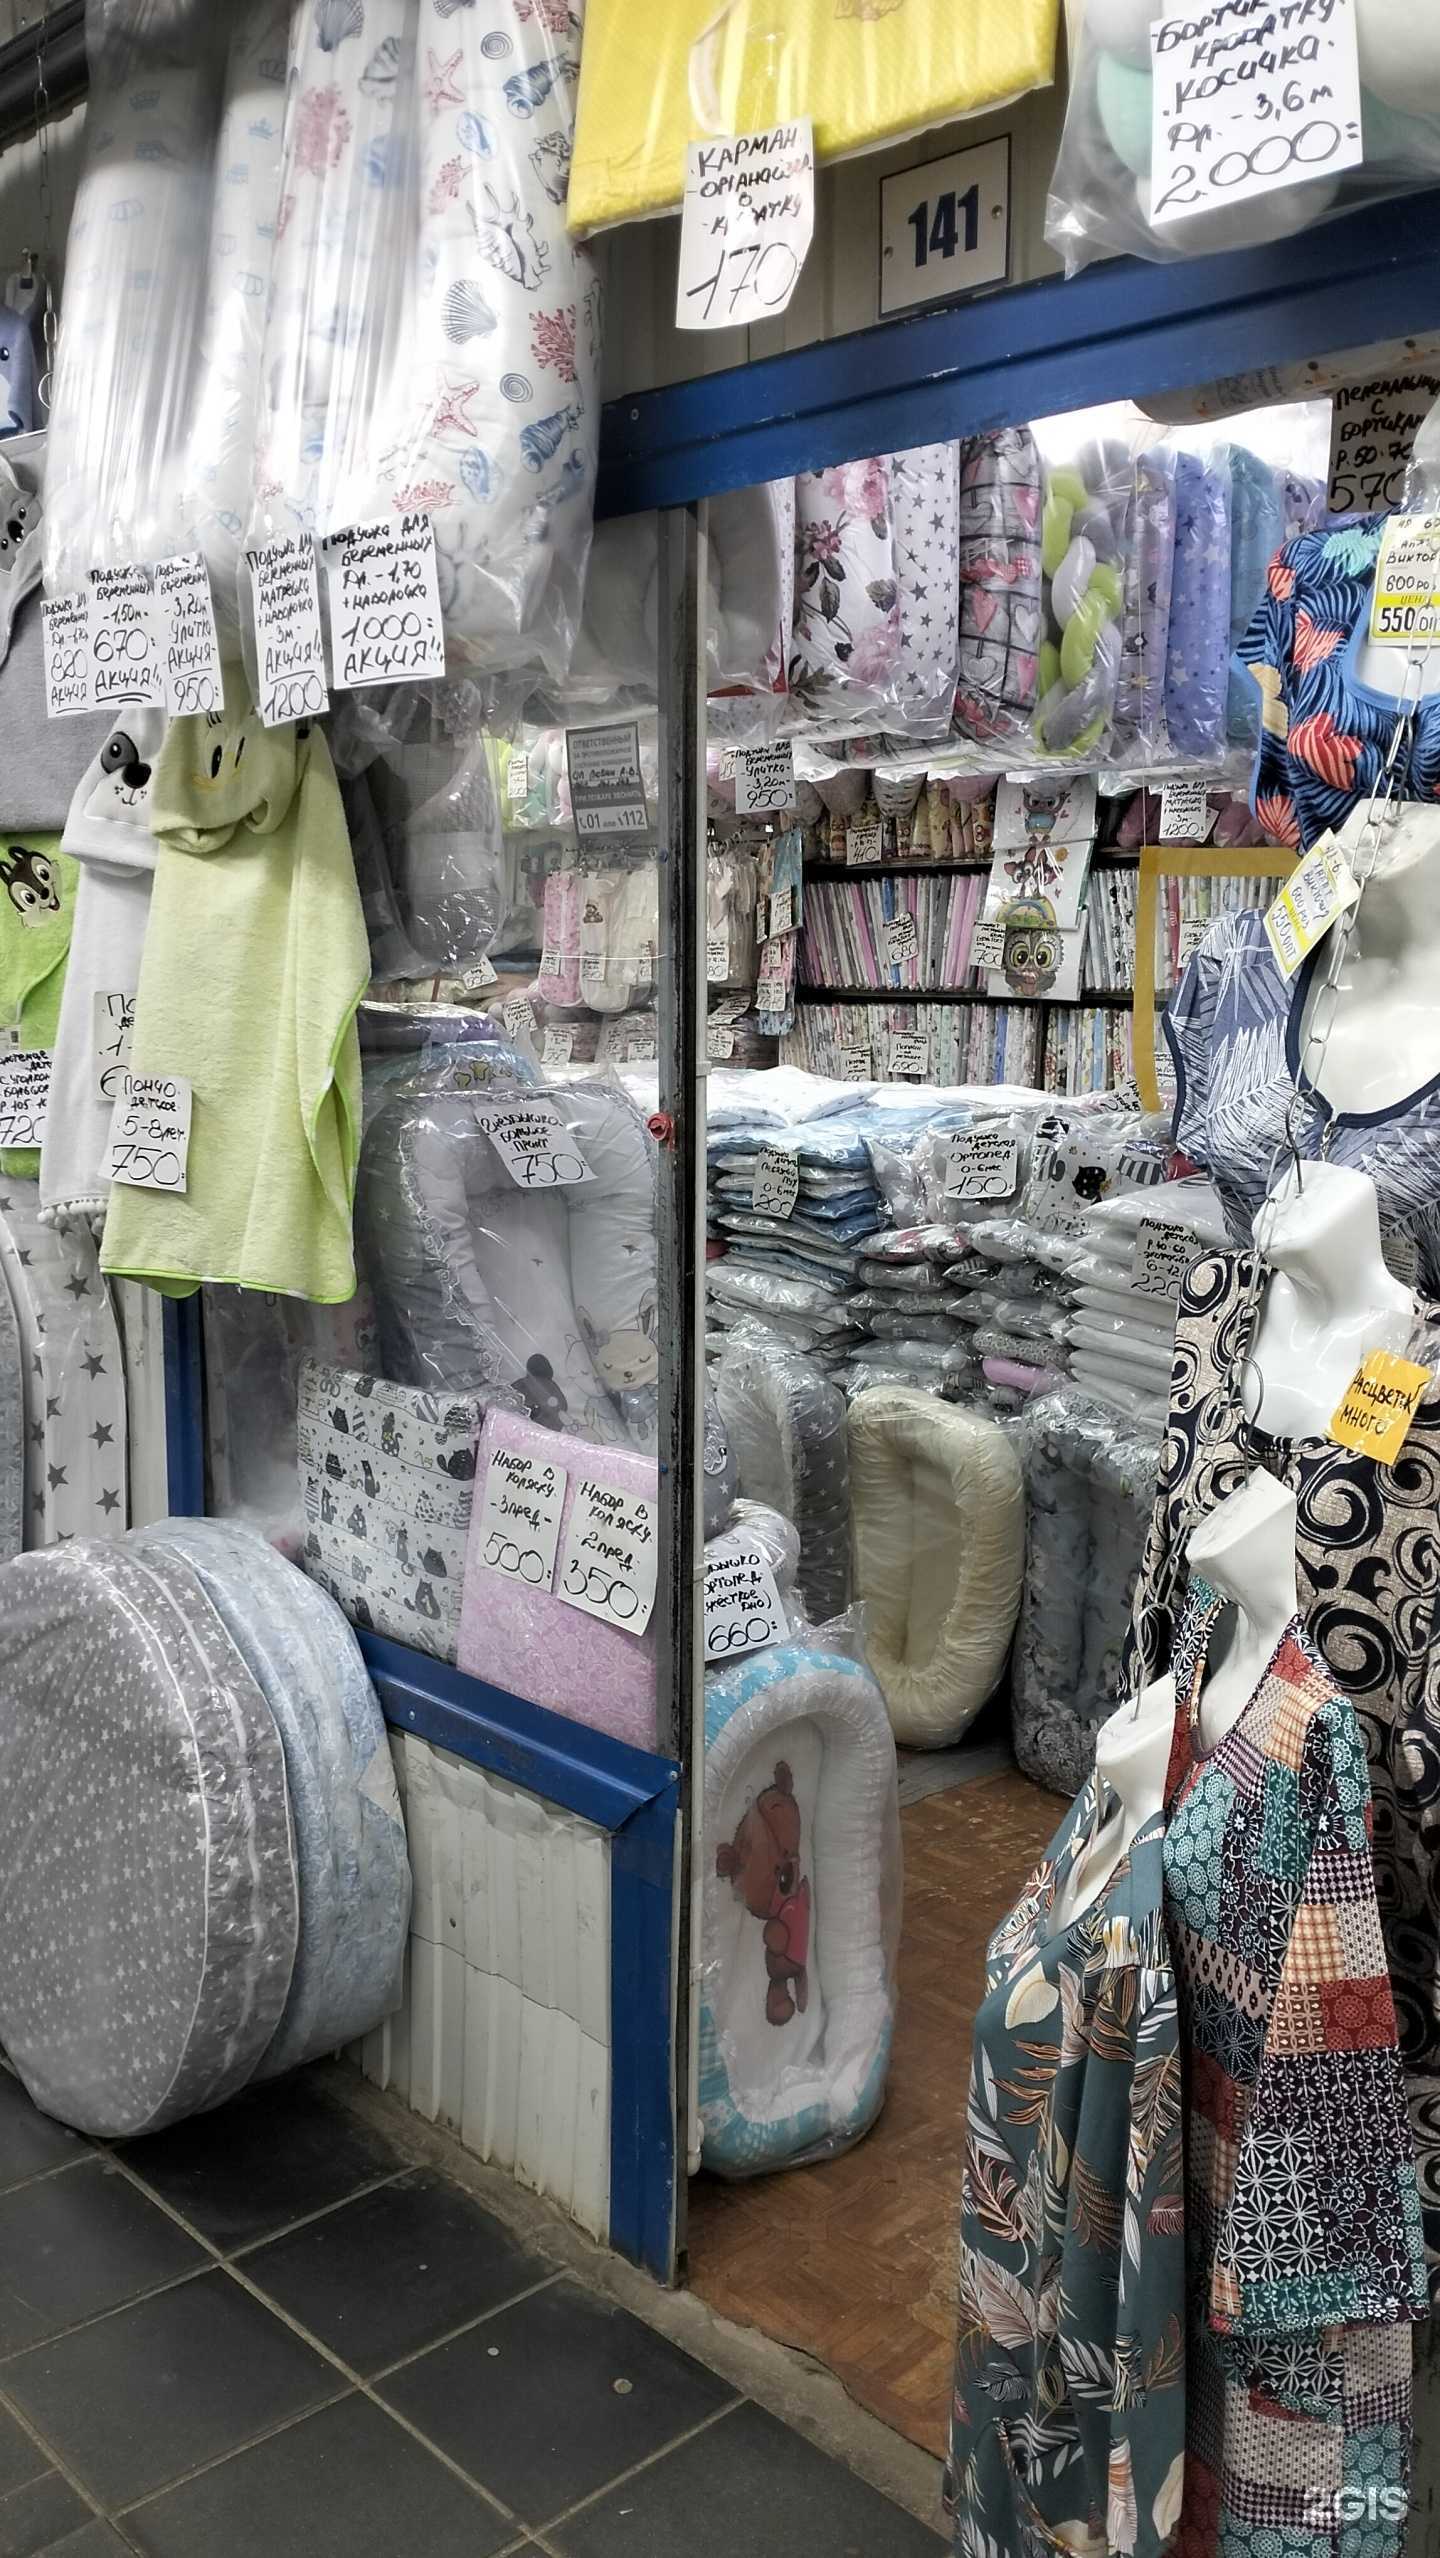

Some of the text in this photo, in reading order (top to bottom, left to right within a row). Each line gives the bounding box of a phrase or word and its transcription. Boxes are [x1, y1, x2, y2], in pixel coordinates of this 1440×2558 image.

[699, 128, 797, 176] КАРМАН
[908, 184, 980, 268] 141
[686, 242, 801, 320] 170
[1379, 607, 1416, 632] 550
[51, 648, 88, 682] 820
[622, 810, 645, 826] 112
